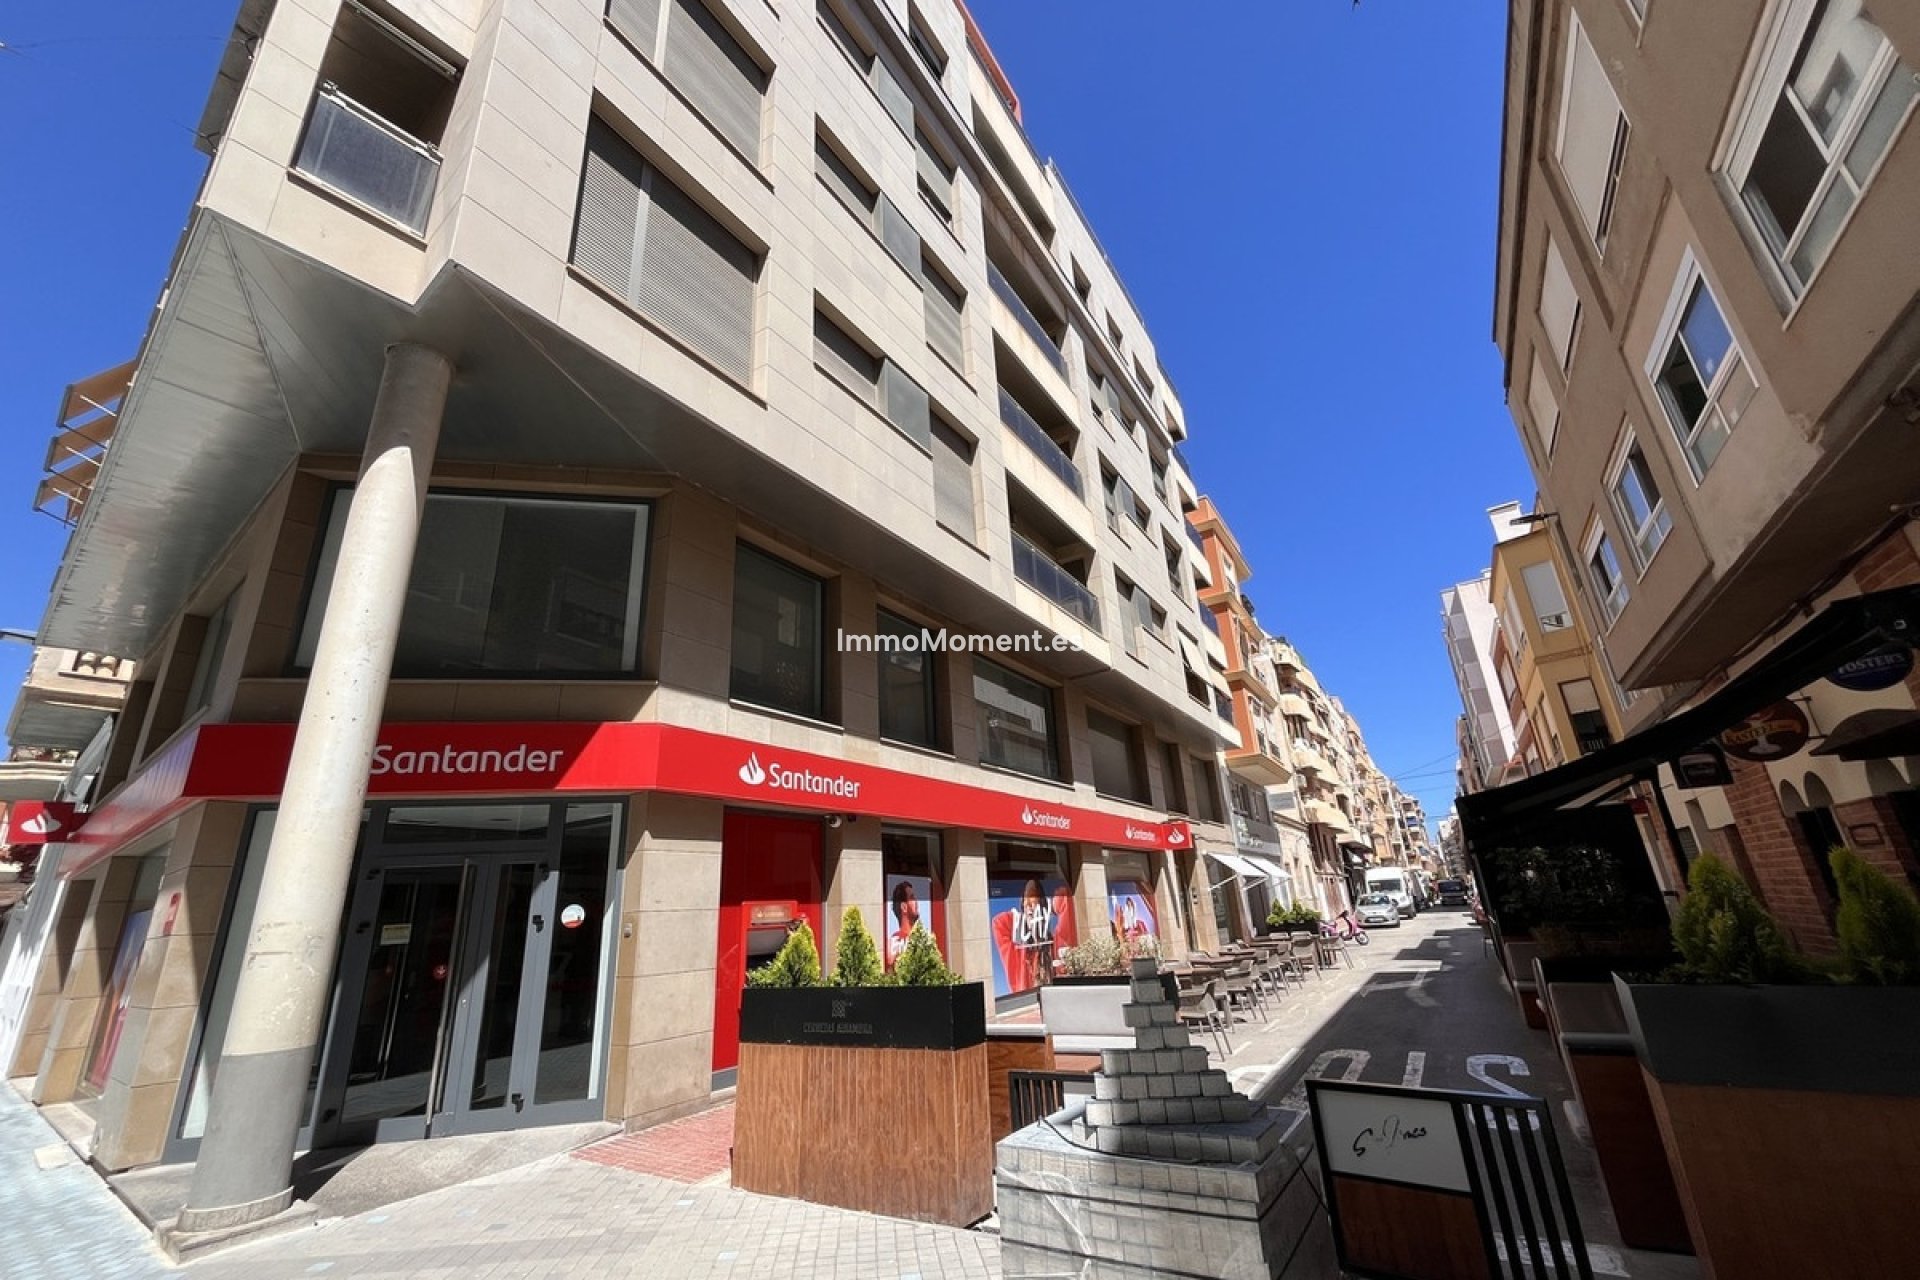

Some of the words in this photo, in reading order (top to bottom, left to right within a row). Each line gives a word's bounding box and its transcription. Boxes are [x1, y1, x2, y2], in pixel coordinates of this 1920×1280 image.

[370, 743, 564, 775] Santander
[768, 762, 862, 799] Santander
[1032, 809, 1072, 830] Santander
[1010, 897, 1053, 944] PLAY
